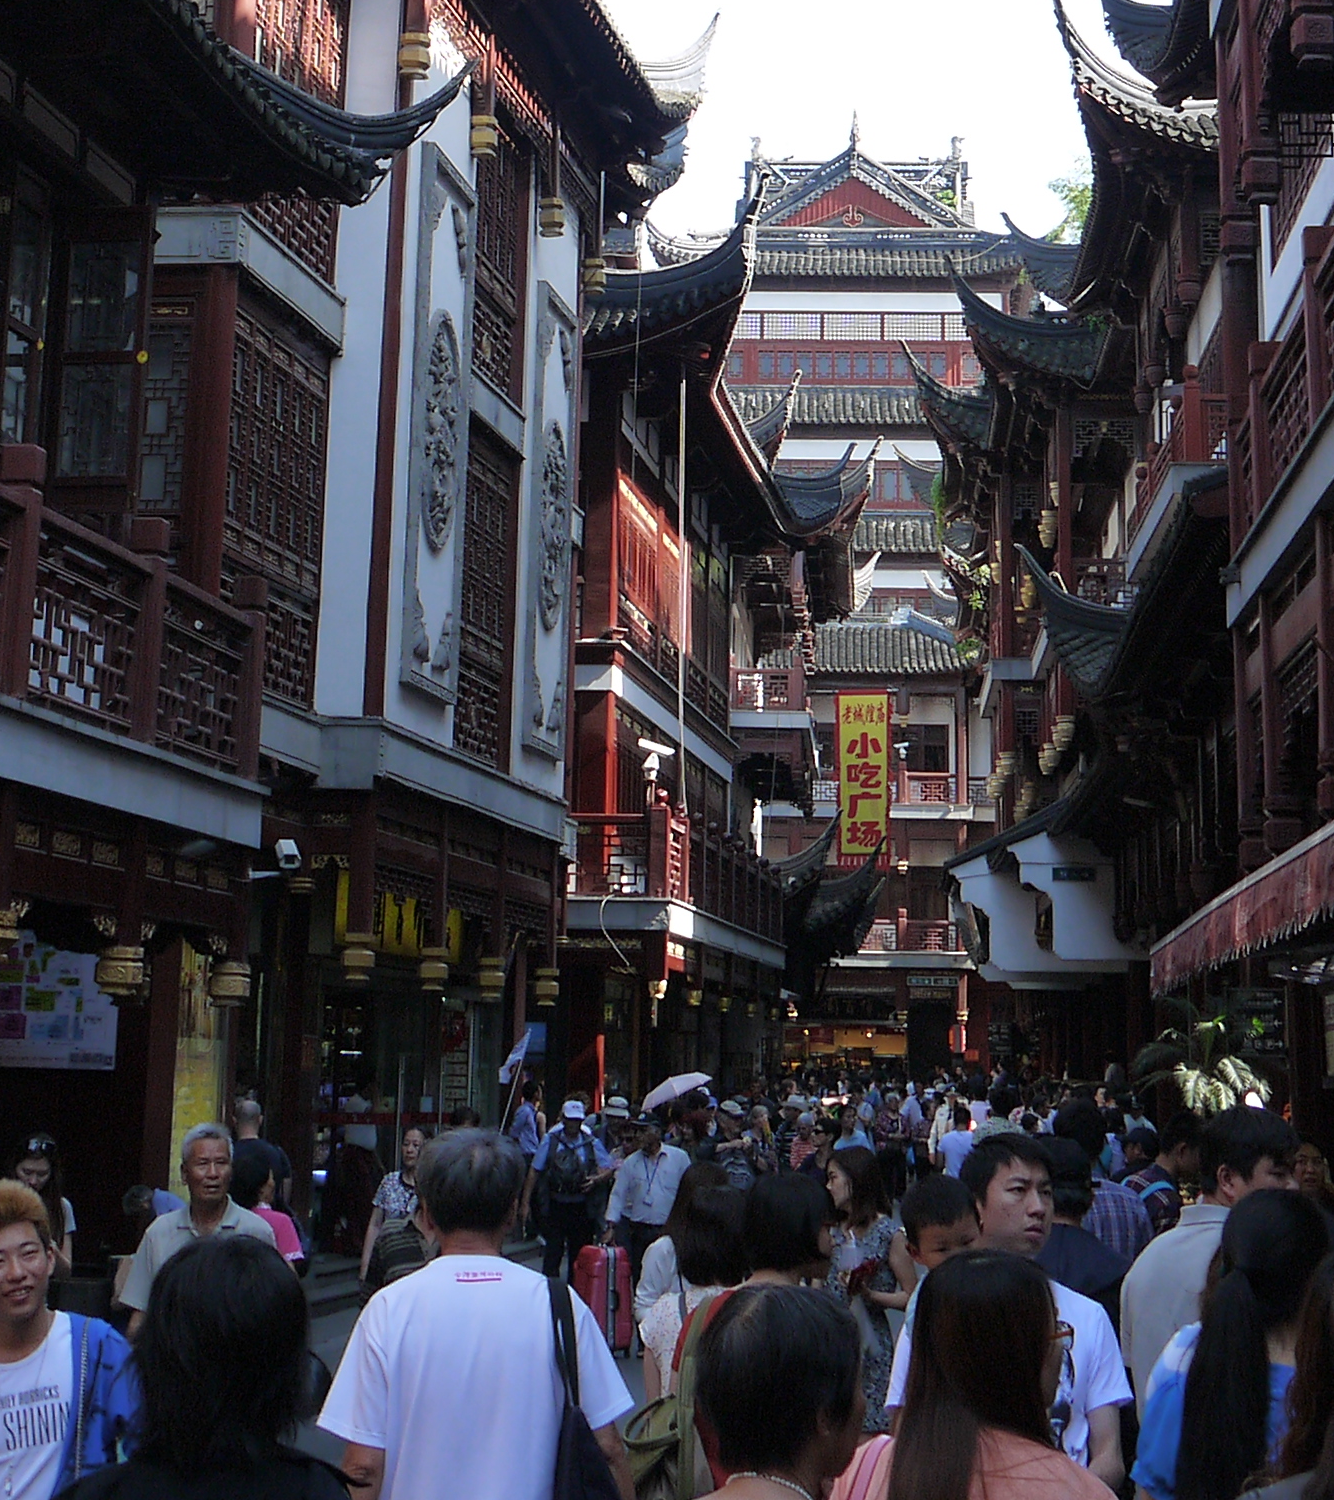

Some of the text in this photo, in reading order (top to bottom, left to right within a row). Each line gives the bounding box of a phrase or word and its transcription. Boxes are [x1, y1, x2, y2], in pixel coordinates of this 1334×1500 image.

[842, 702, 886, 726] 老城隍庙
[846, 731, 883, 848] 小吃广场
[3, 1401, 71, 1451] SHININ
